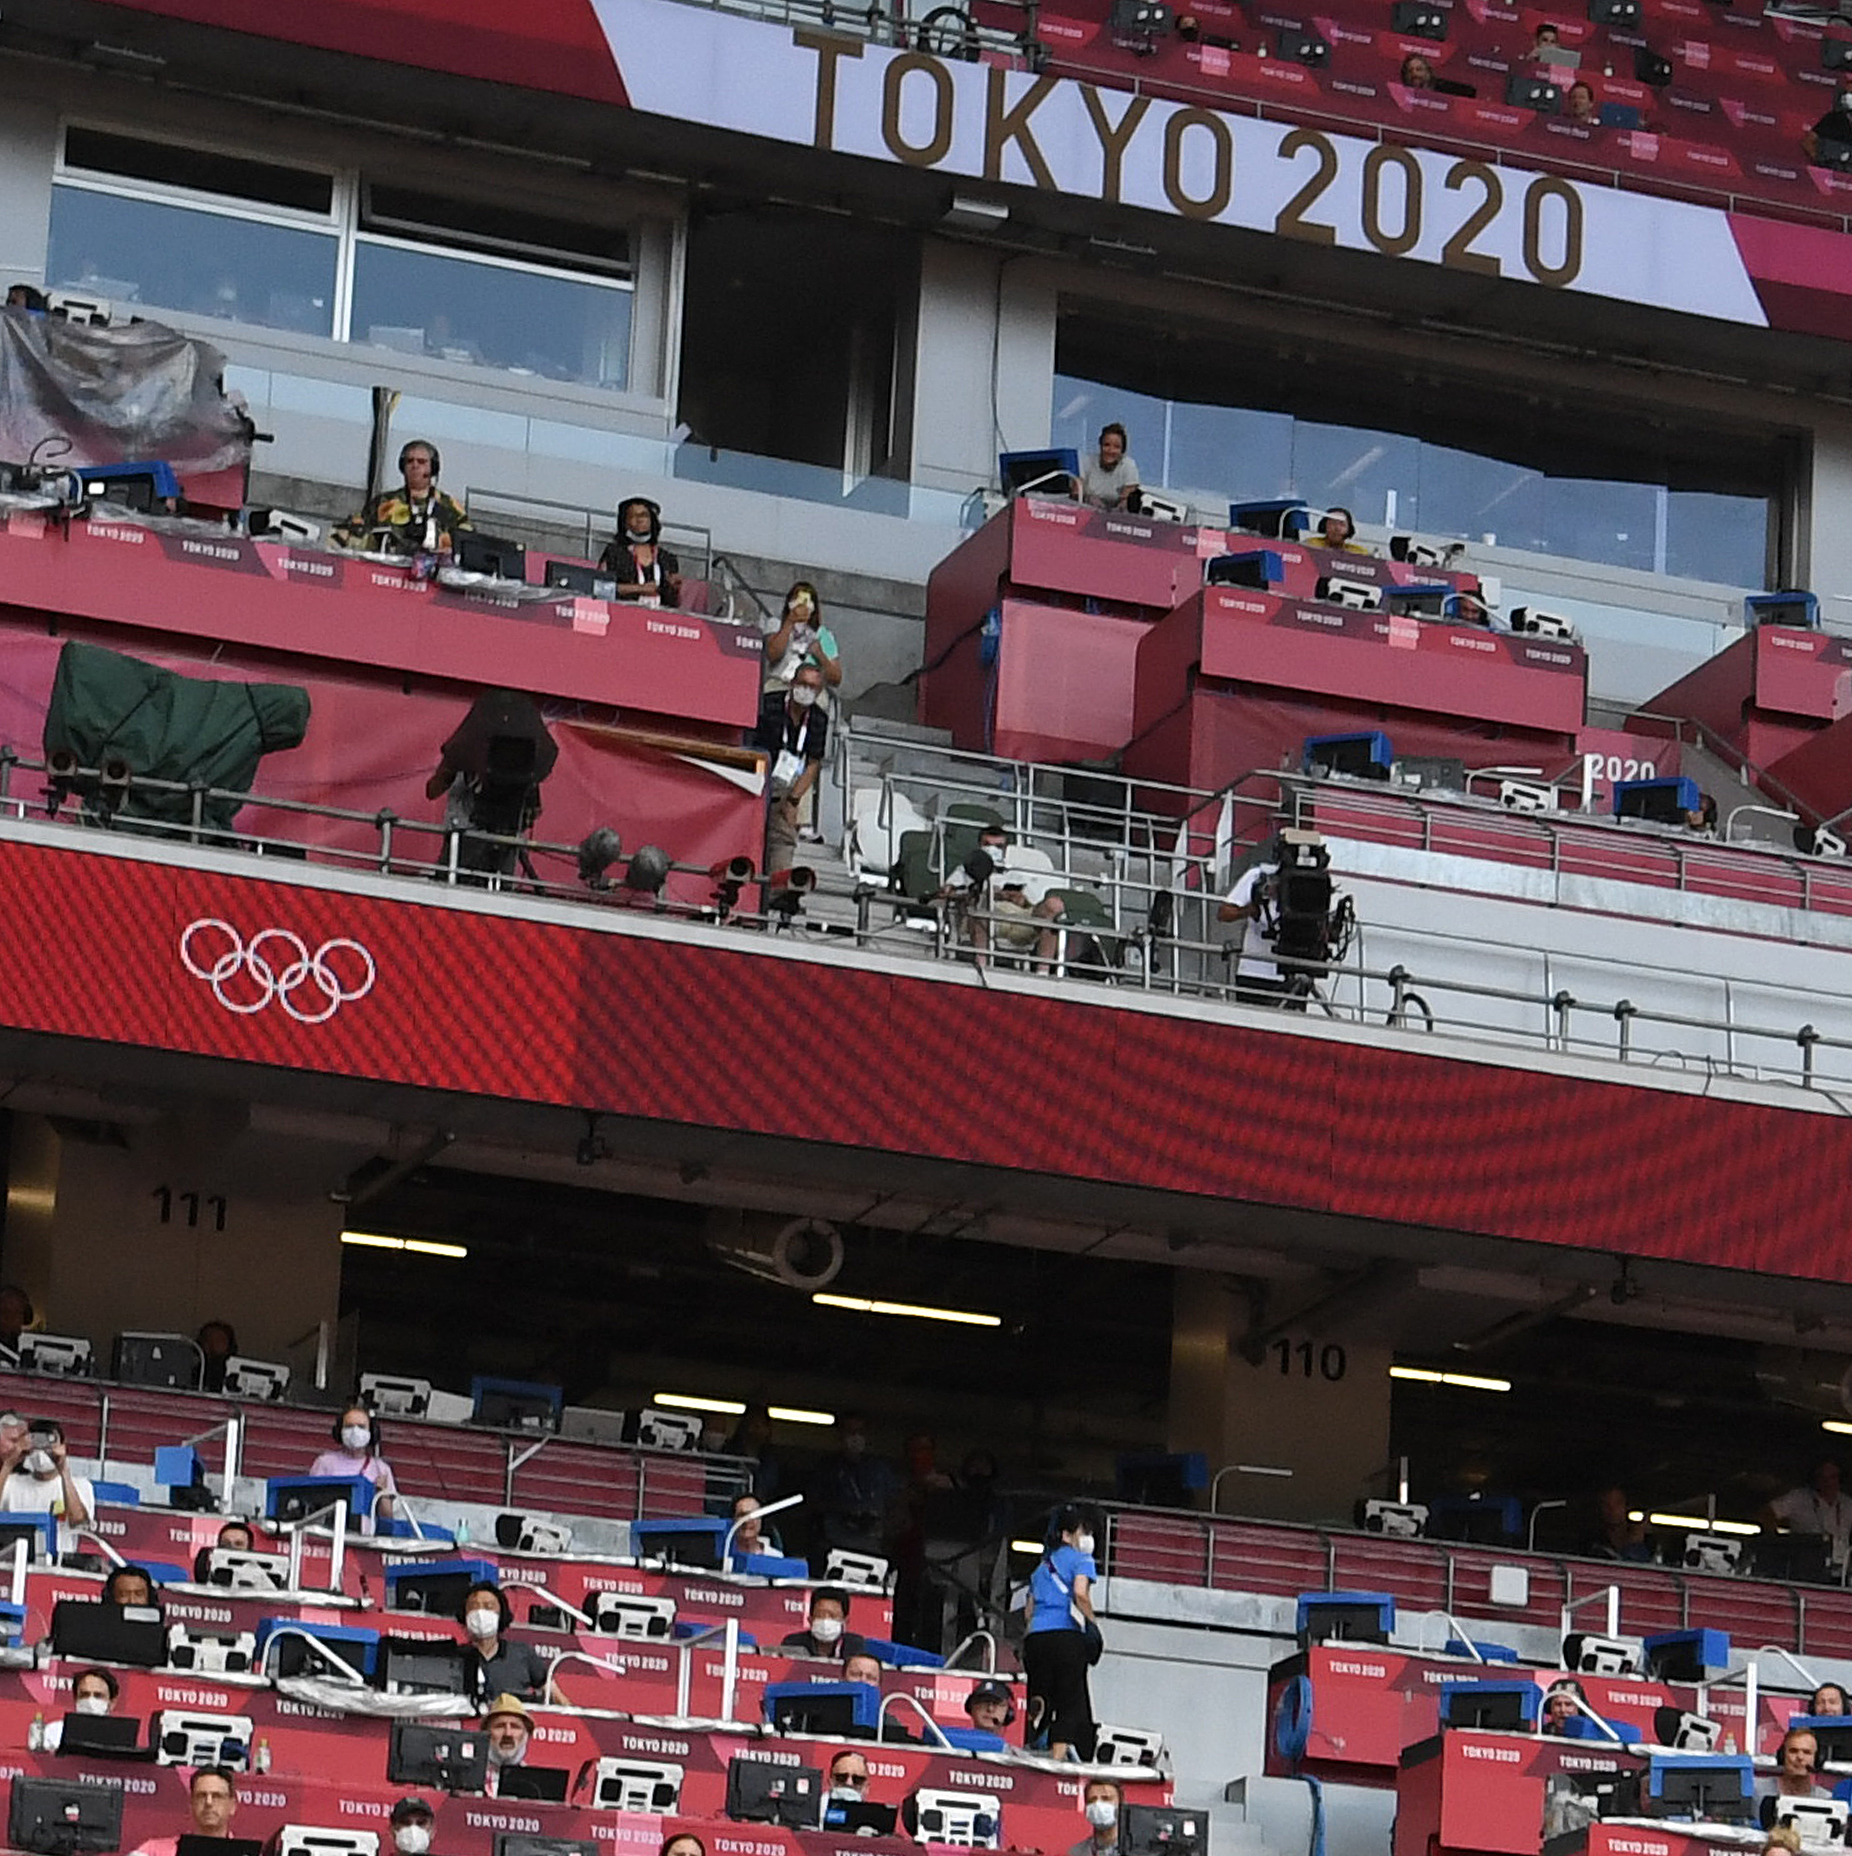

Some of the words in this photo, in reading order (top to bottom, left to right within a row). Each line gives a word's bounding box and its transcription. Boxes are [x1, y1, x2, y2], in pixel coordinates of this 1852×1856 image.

[792, 26, 1234, 219] TOKYO
[1274, 129, 1583, 289] 2020
[153, 1187, 226, 1231] 111
[1272, 1338, 1346, 1381] 110
